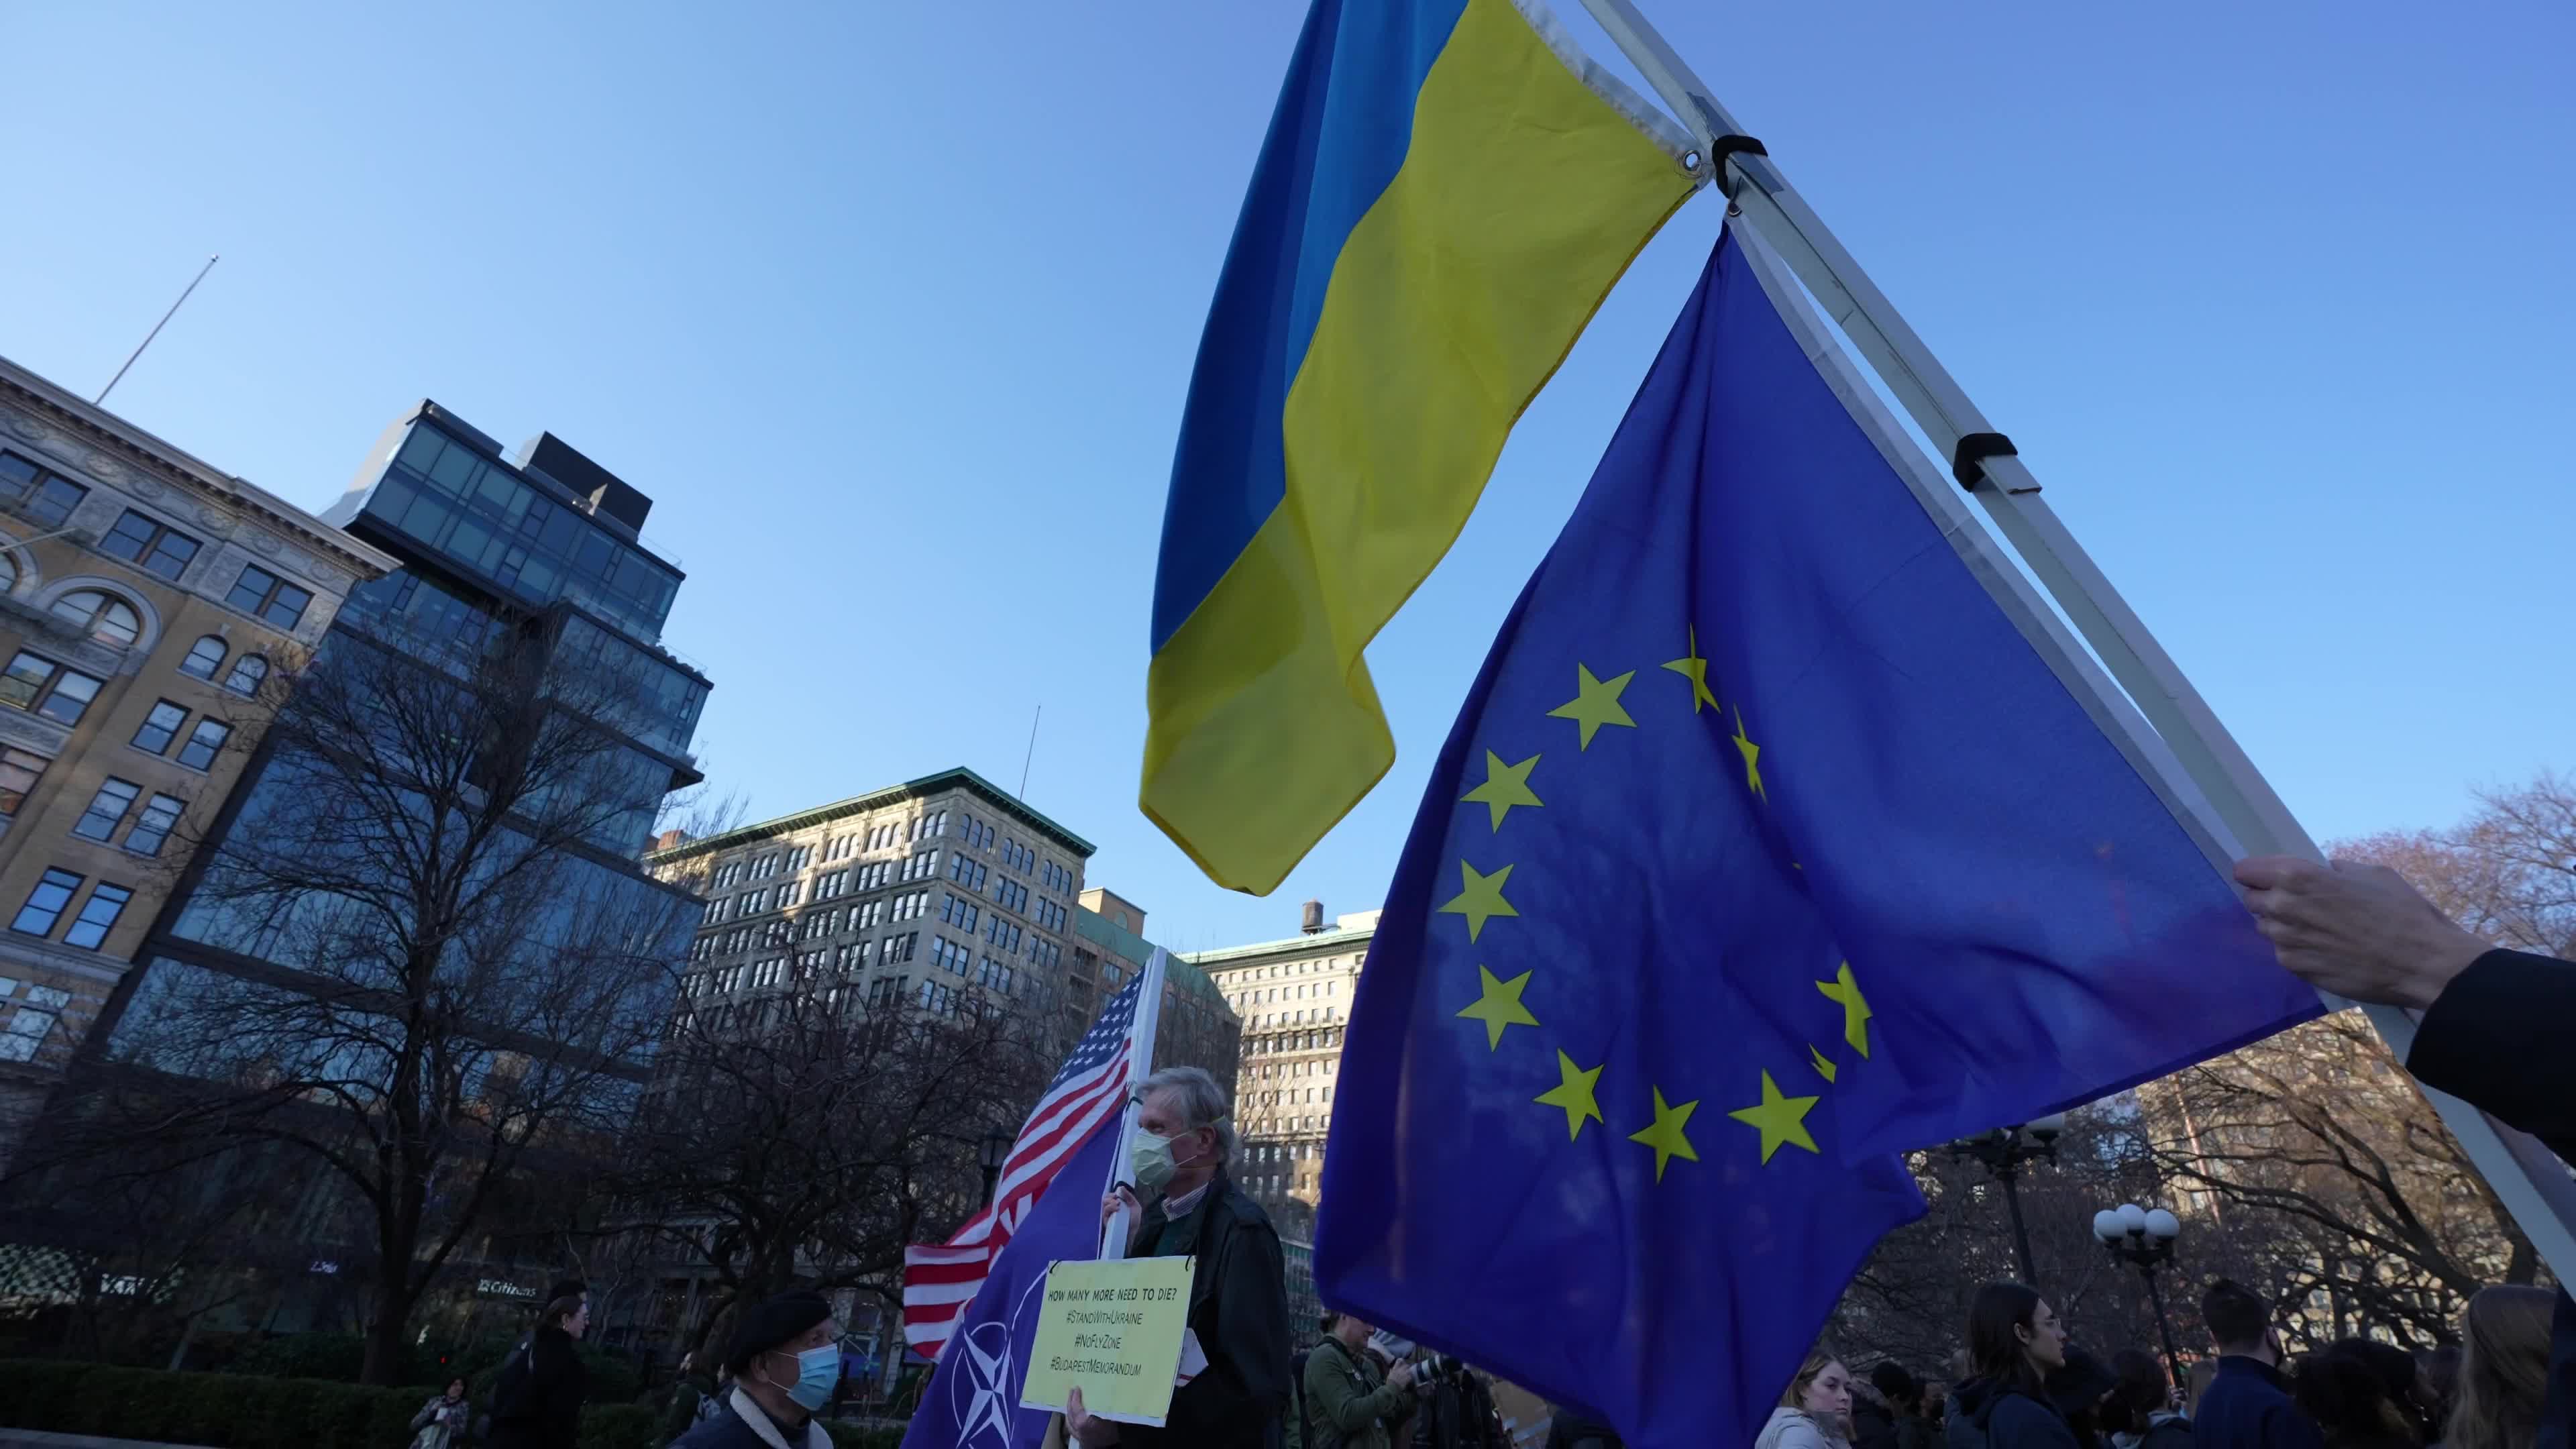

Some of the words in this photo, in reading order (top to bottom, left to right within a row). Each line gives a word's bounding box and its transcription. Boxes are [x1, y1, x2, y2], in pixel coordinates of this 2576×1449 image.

[1048, 1289, 1065, 1302] HOW
[1067, 1289, 1090, 1301] MANY
[1092, 1289, 1114, 1301] MORE
[1117, 1288, 1138, 1301] NEED
[1142, 1288, 1155, 1301] TO
[1157, 1287, 1177, 1301] DIE?
